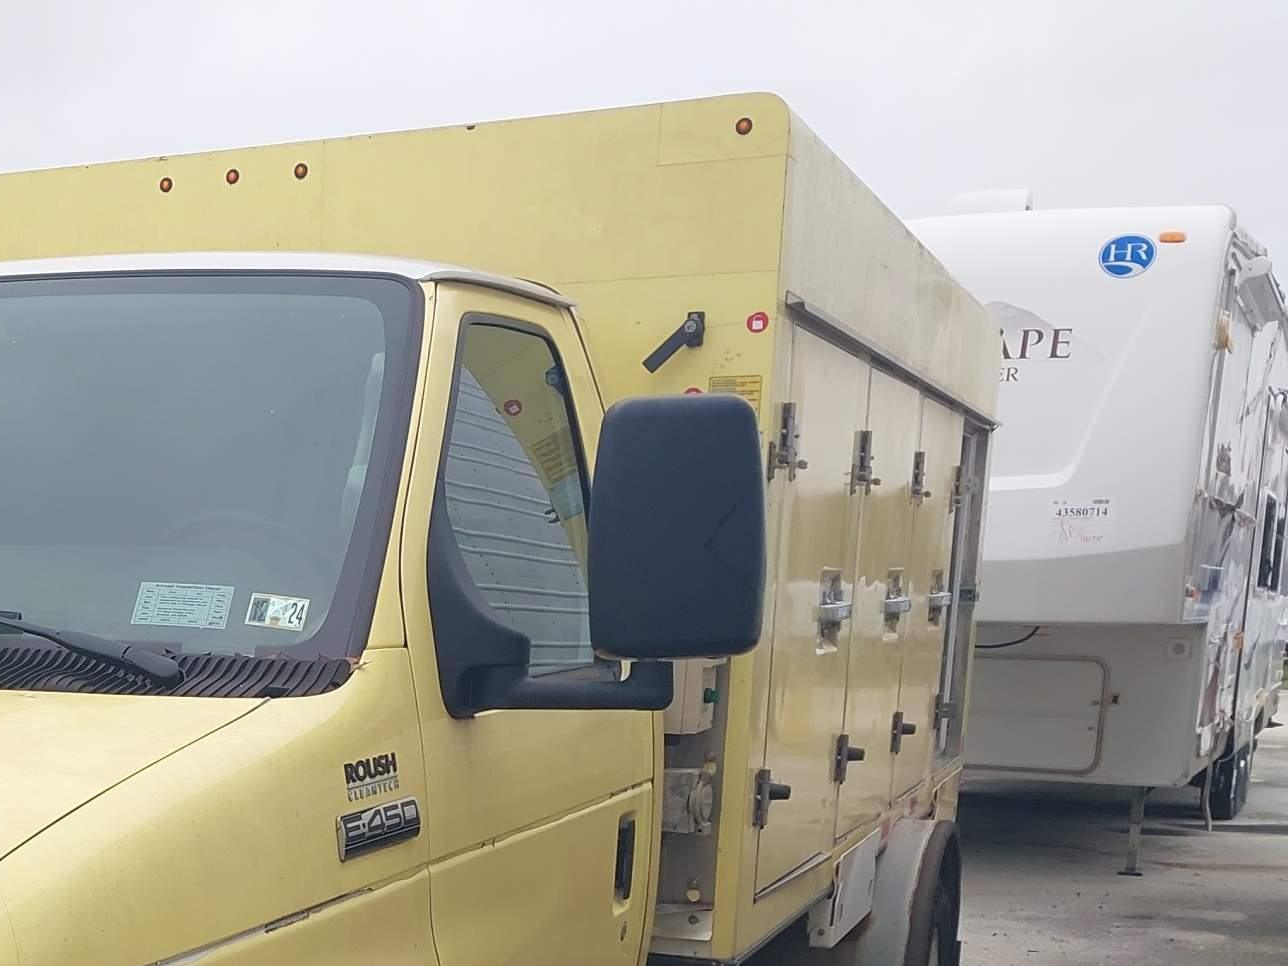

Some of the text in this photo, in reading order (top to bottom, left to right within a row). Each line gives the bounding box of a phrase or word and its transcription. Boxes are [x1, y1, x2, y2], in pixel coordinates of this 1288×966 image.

[1108, 242, 1148, 262] HR
[1055, 506, 1109, 518] 43580714
[287, 602, 305, 626] 24
[343, 752, 398, 785] ROUSH
[347, 779, 400, 803] CLEANTECH
[342, 799, 421, 844] E-450
